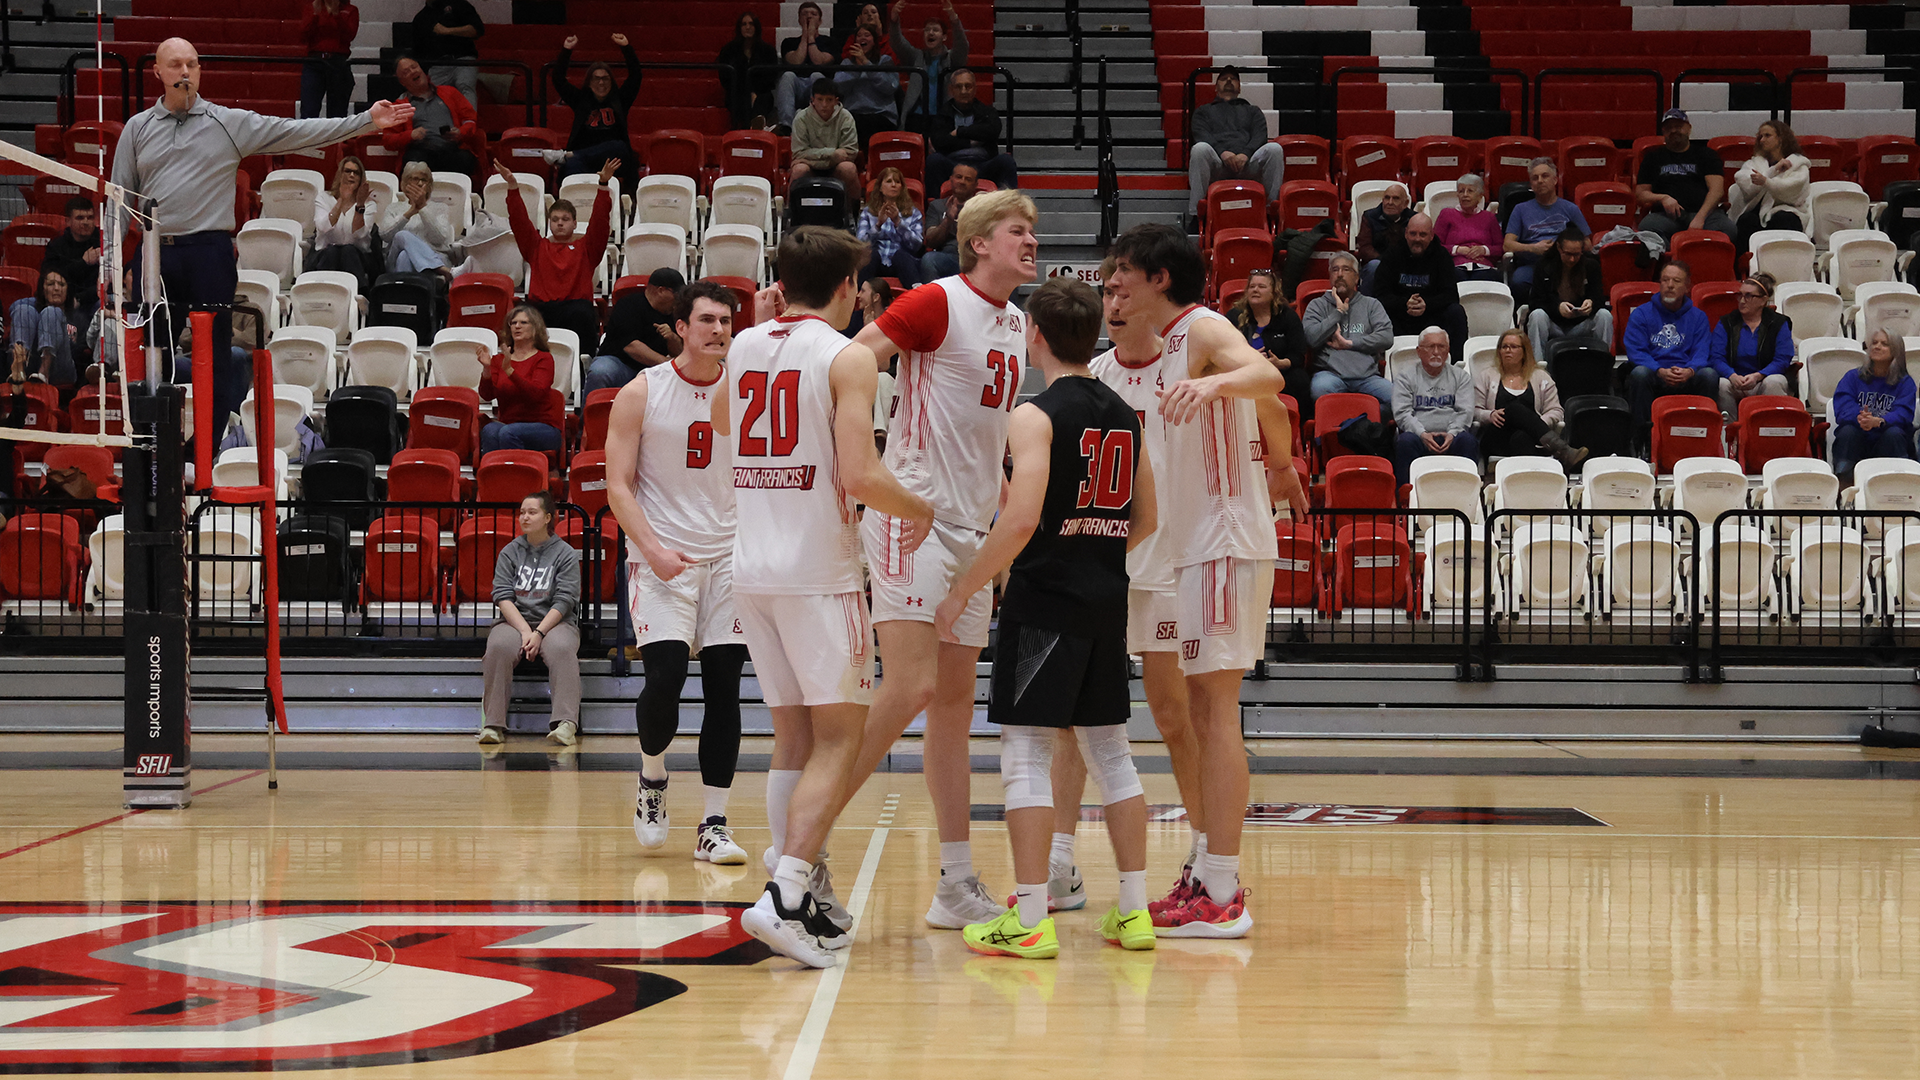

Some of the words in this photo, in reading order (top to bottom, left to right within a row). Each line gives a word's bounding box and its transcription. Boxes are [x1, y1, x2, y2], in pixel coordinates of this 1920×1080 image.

[980, 348, 1019, 413] 31
[738, 370, 802, 457] 20
[686, 420, 713, 469] 9
[1076, 428, 1134, 510] 30
[147, 635, 162, 681] sports
[1182, 639, 1200, 661] FU
[147, 683, 162, 739] imports
[136, 755, 171, 776] SFU
